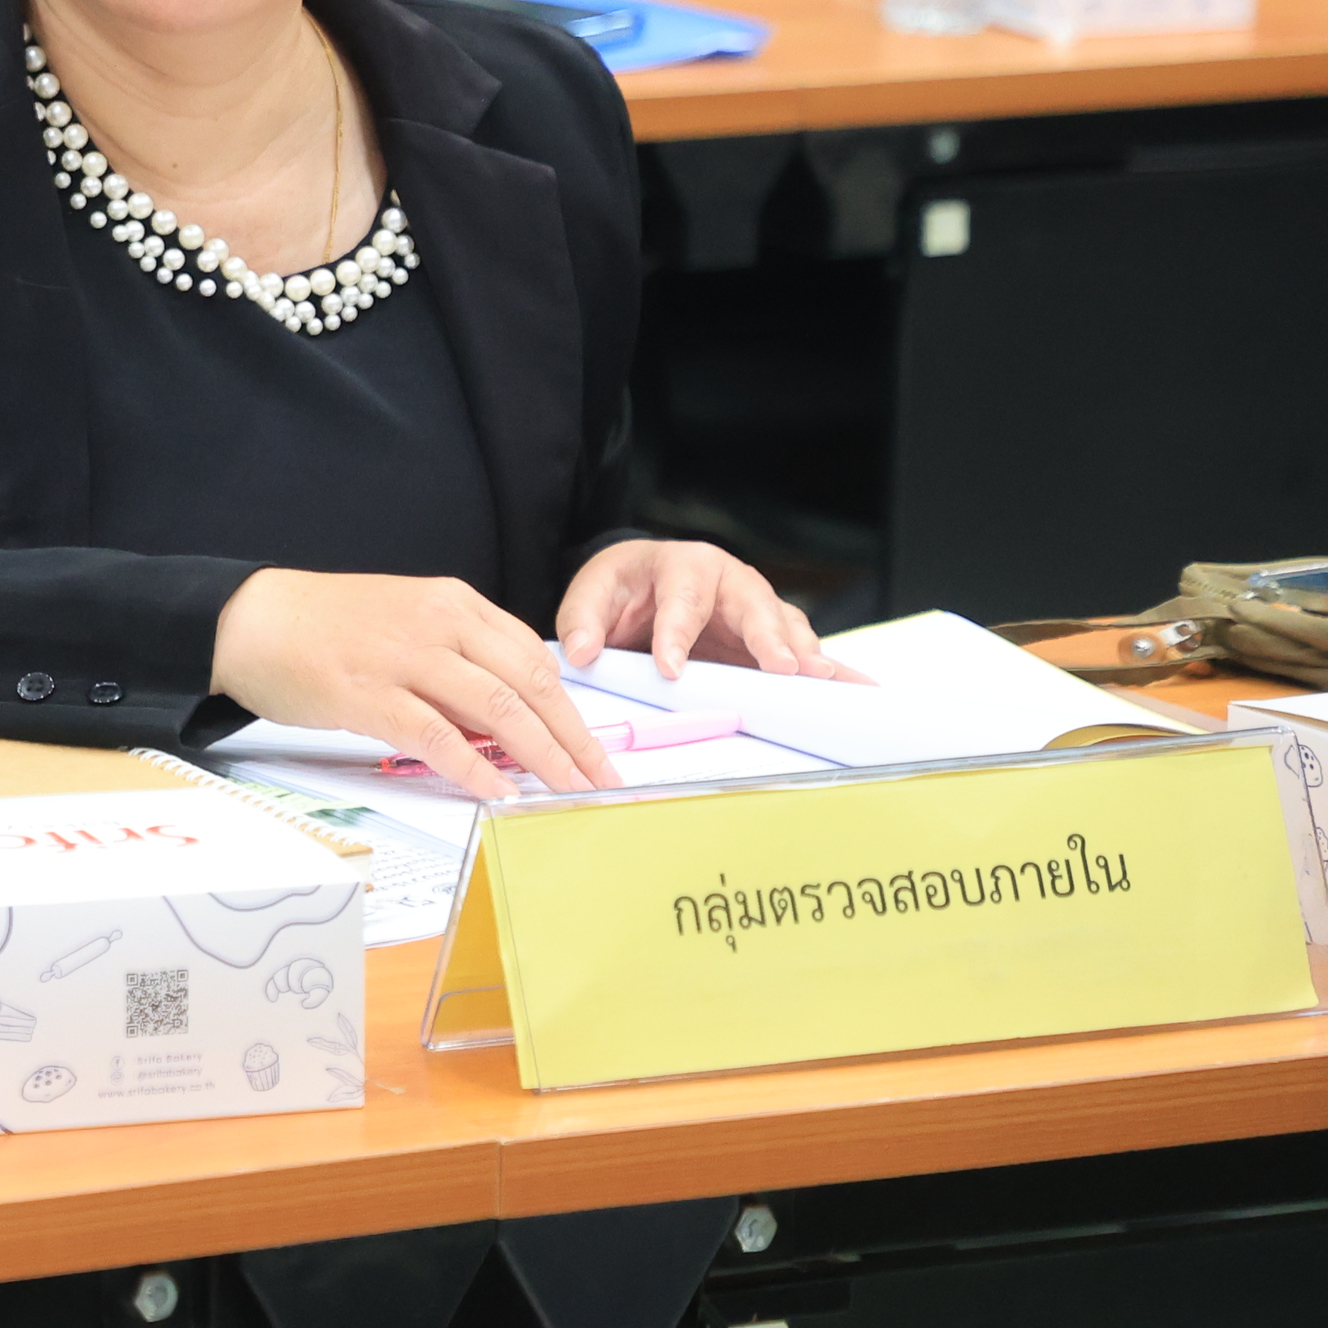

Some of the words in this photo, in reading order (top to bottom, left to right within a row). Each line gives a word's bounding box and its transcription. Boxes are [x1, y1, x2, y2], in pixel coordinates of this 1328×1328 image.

[673, 833, 1132, 953] กลุ่มตรวจสอบภายใน
